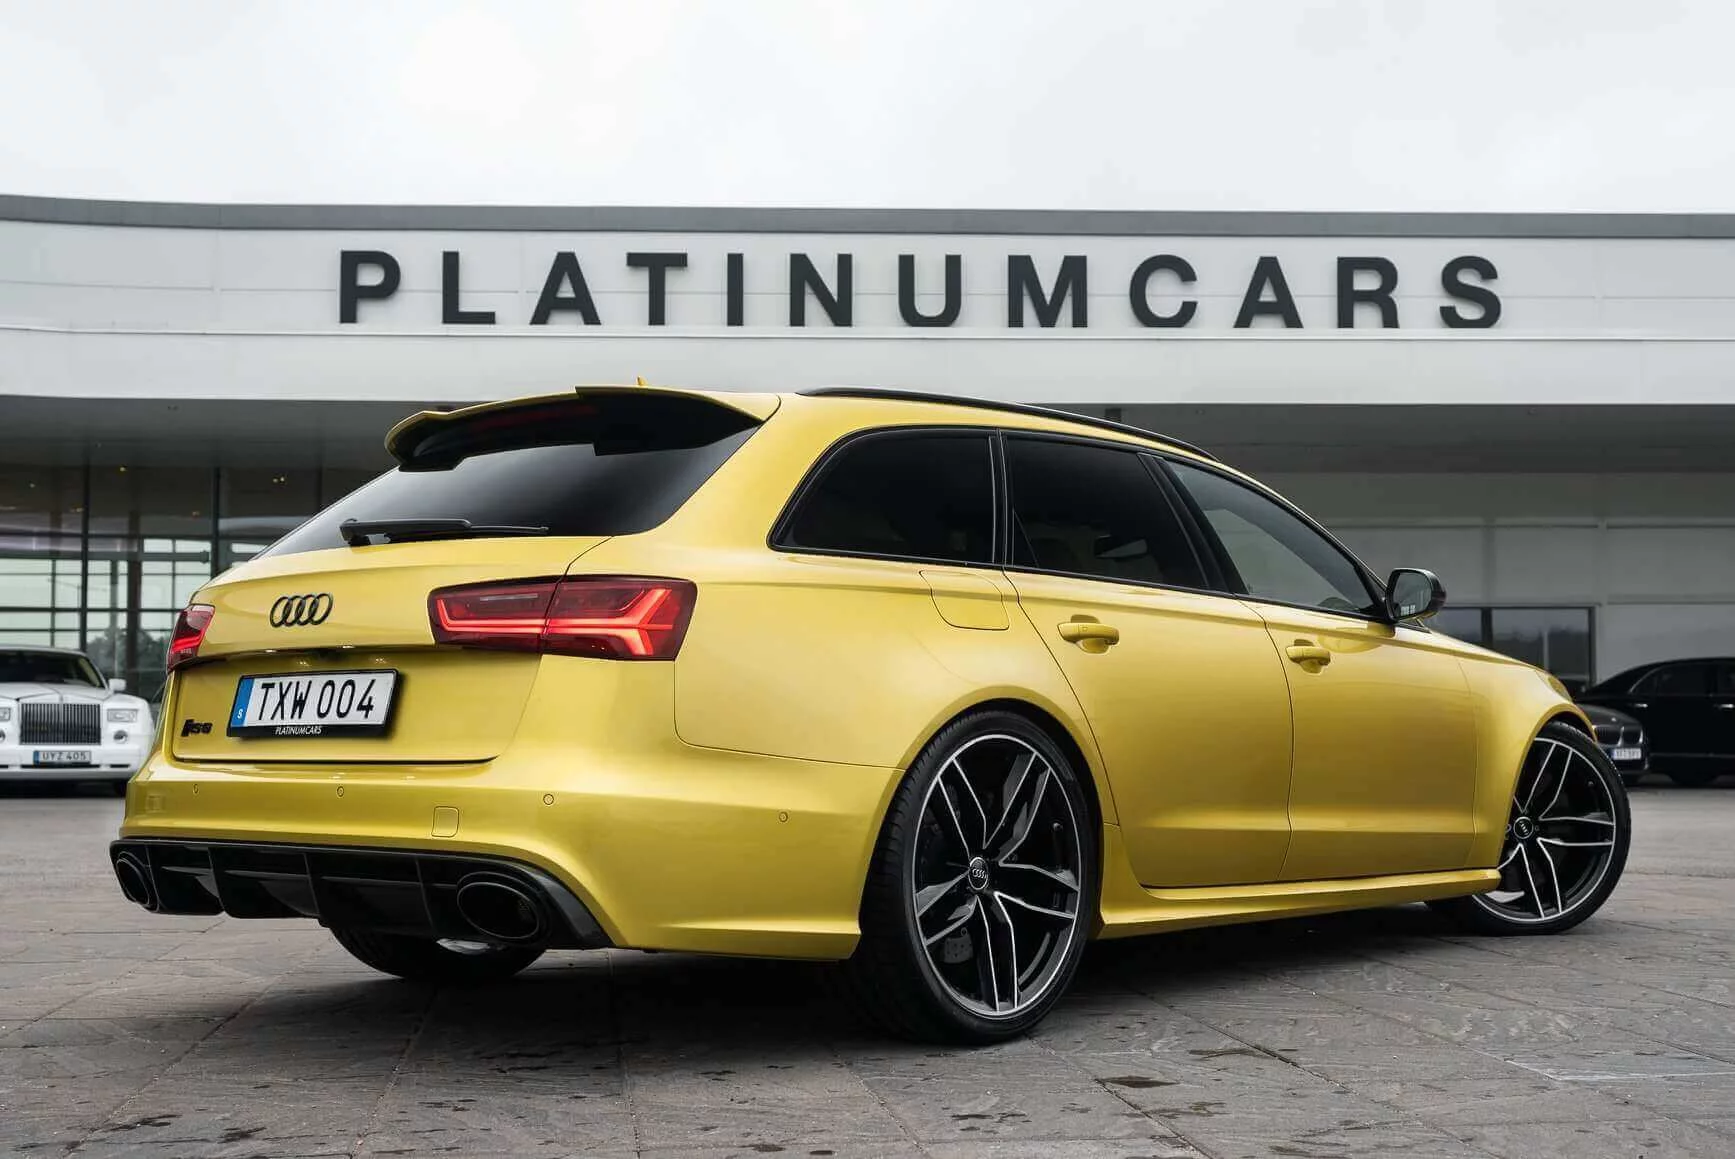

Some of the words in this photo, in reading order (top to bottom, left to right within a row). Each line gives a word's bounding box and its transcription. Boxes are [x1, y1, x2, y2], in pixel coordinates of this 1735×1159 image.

[339, 250, 1502, 328] PLATINUMCARS
[258, 680, 312, 721] TXW
[317, 678, 376, 719] 004
[237, 708, 244, 719] S
[275, 725, 322, 735] PLATINUMCARS
[42, 751, 63, 760] UYZ
[66, 751, 86, 760] 405
